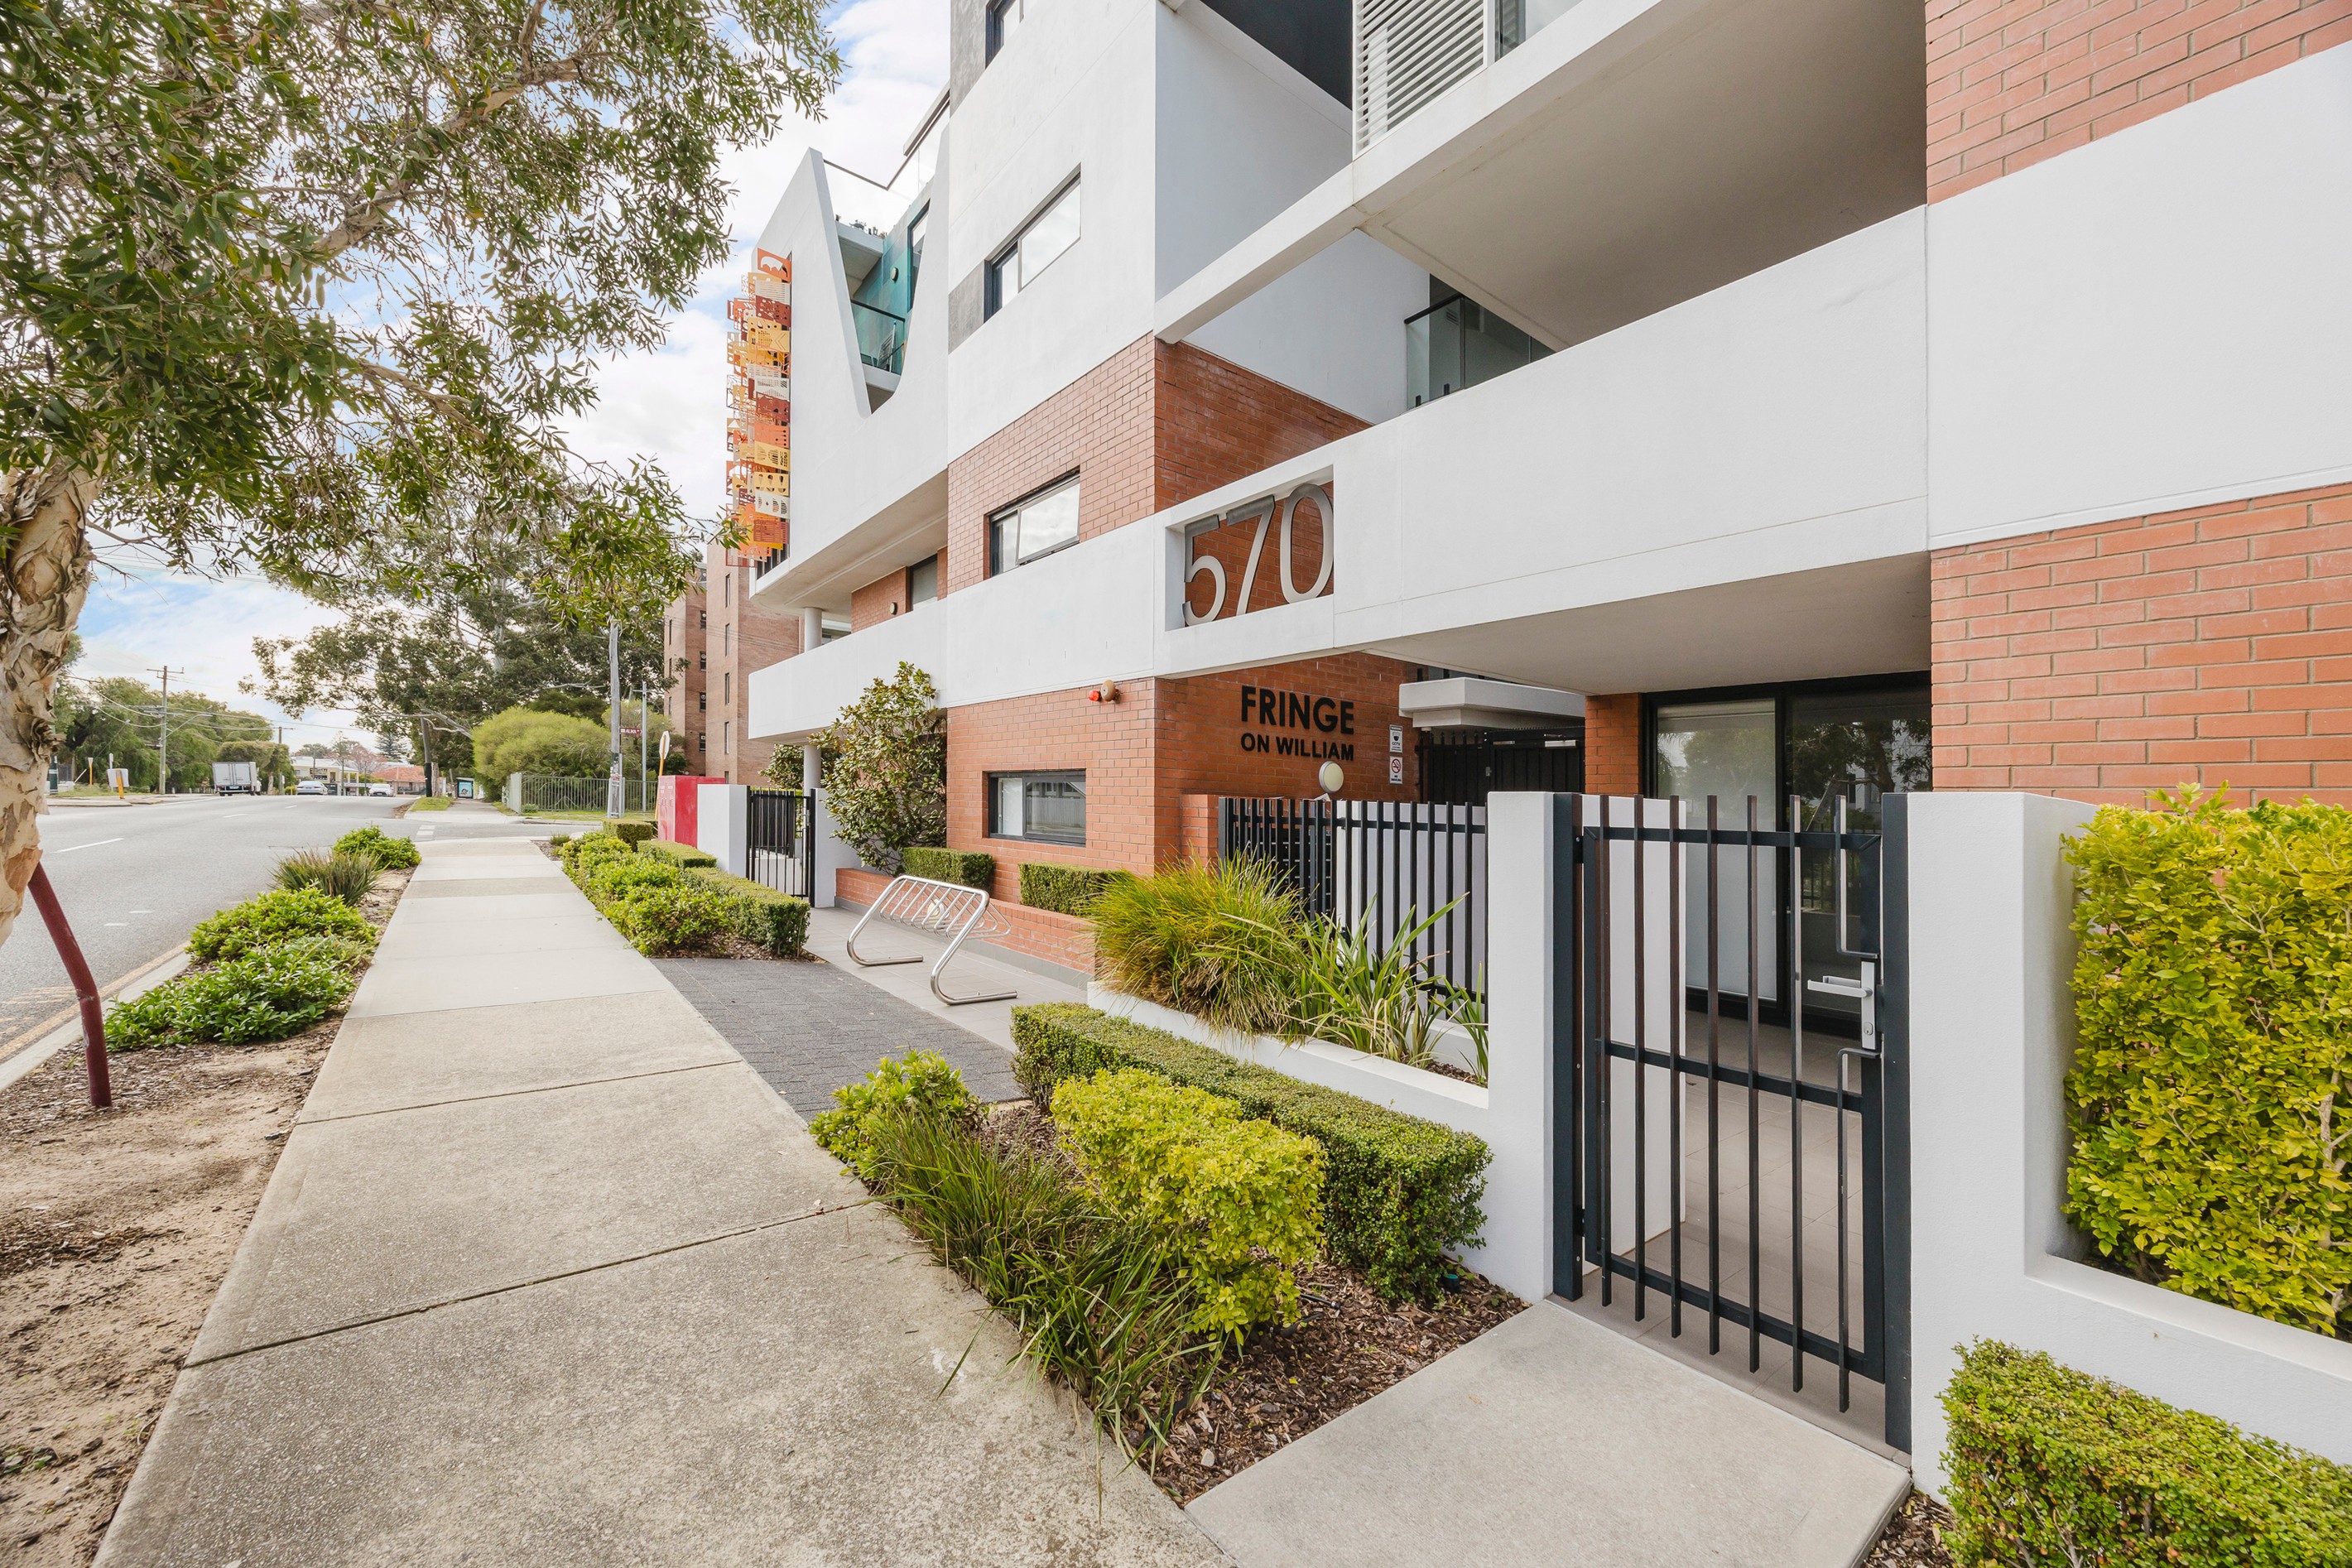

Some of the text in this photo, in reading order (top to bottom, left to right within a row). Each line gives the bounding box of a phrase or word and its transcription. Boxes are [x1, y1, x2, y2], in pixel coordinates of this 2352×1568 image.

[1182, 483, 1334, 627] 570
[1241, 685, 1354, 735] FRINGE
[1241, 733, 1354, 761] ON WILLIAM
